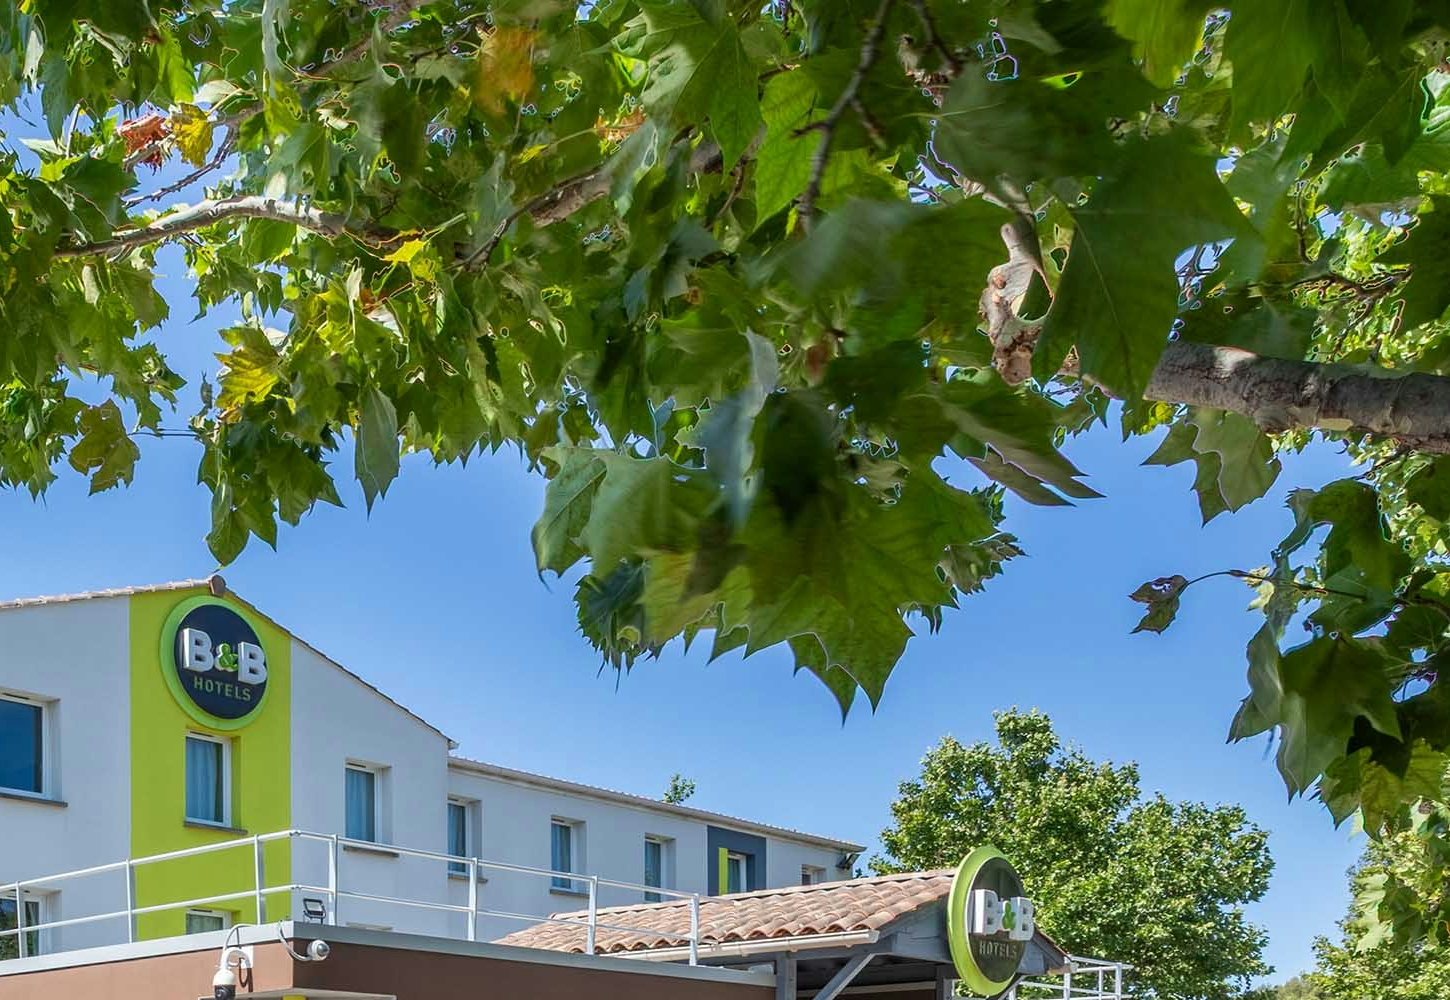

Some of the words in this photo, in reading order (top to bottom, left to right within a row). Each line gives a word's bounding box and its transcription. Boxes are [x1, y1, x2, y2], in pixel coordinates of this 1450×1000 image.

[183, 628, 267, 685] B&B
[194, 676, 251, 701] HOTELS
[974, 889, 1034, 941] B&B
[979, 940, 1017, 959] HOTELS
